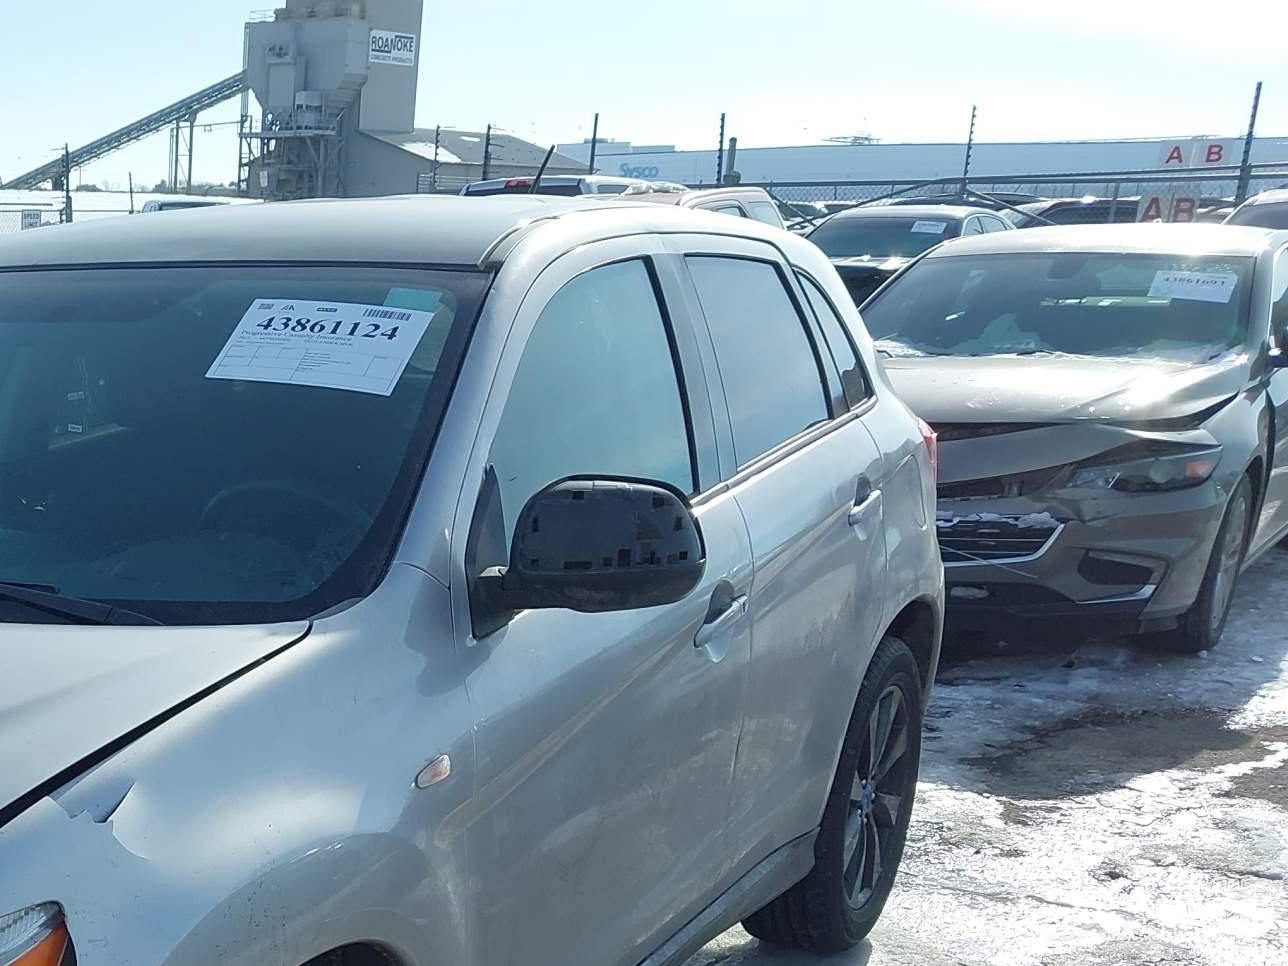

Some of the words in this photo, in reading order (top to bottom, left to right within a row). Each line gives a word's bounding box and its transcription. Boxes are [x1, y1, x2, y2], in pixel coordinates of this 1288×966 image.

[372, 35, 414, 53] ROANOKE
[1165, 145, 1183, 164] A
[1205, 144, 1223, 163] B
[620, 163, 660, 178] Sysco
[1139, 196, 1162, 223] A
[1173, 197, 1196, 223] B
[241, 329, 283, 338] Progressive
[284, 331, 315, 340] Casualty
[256, 315, 400, 341] 43861124
